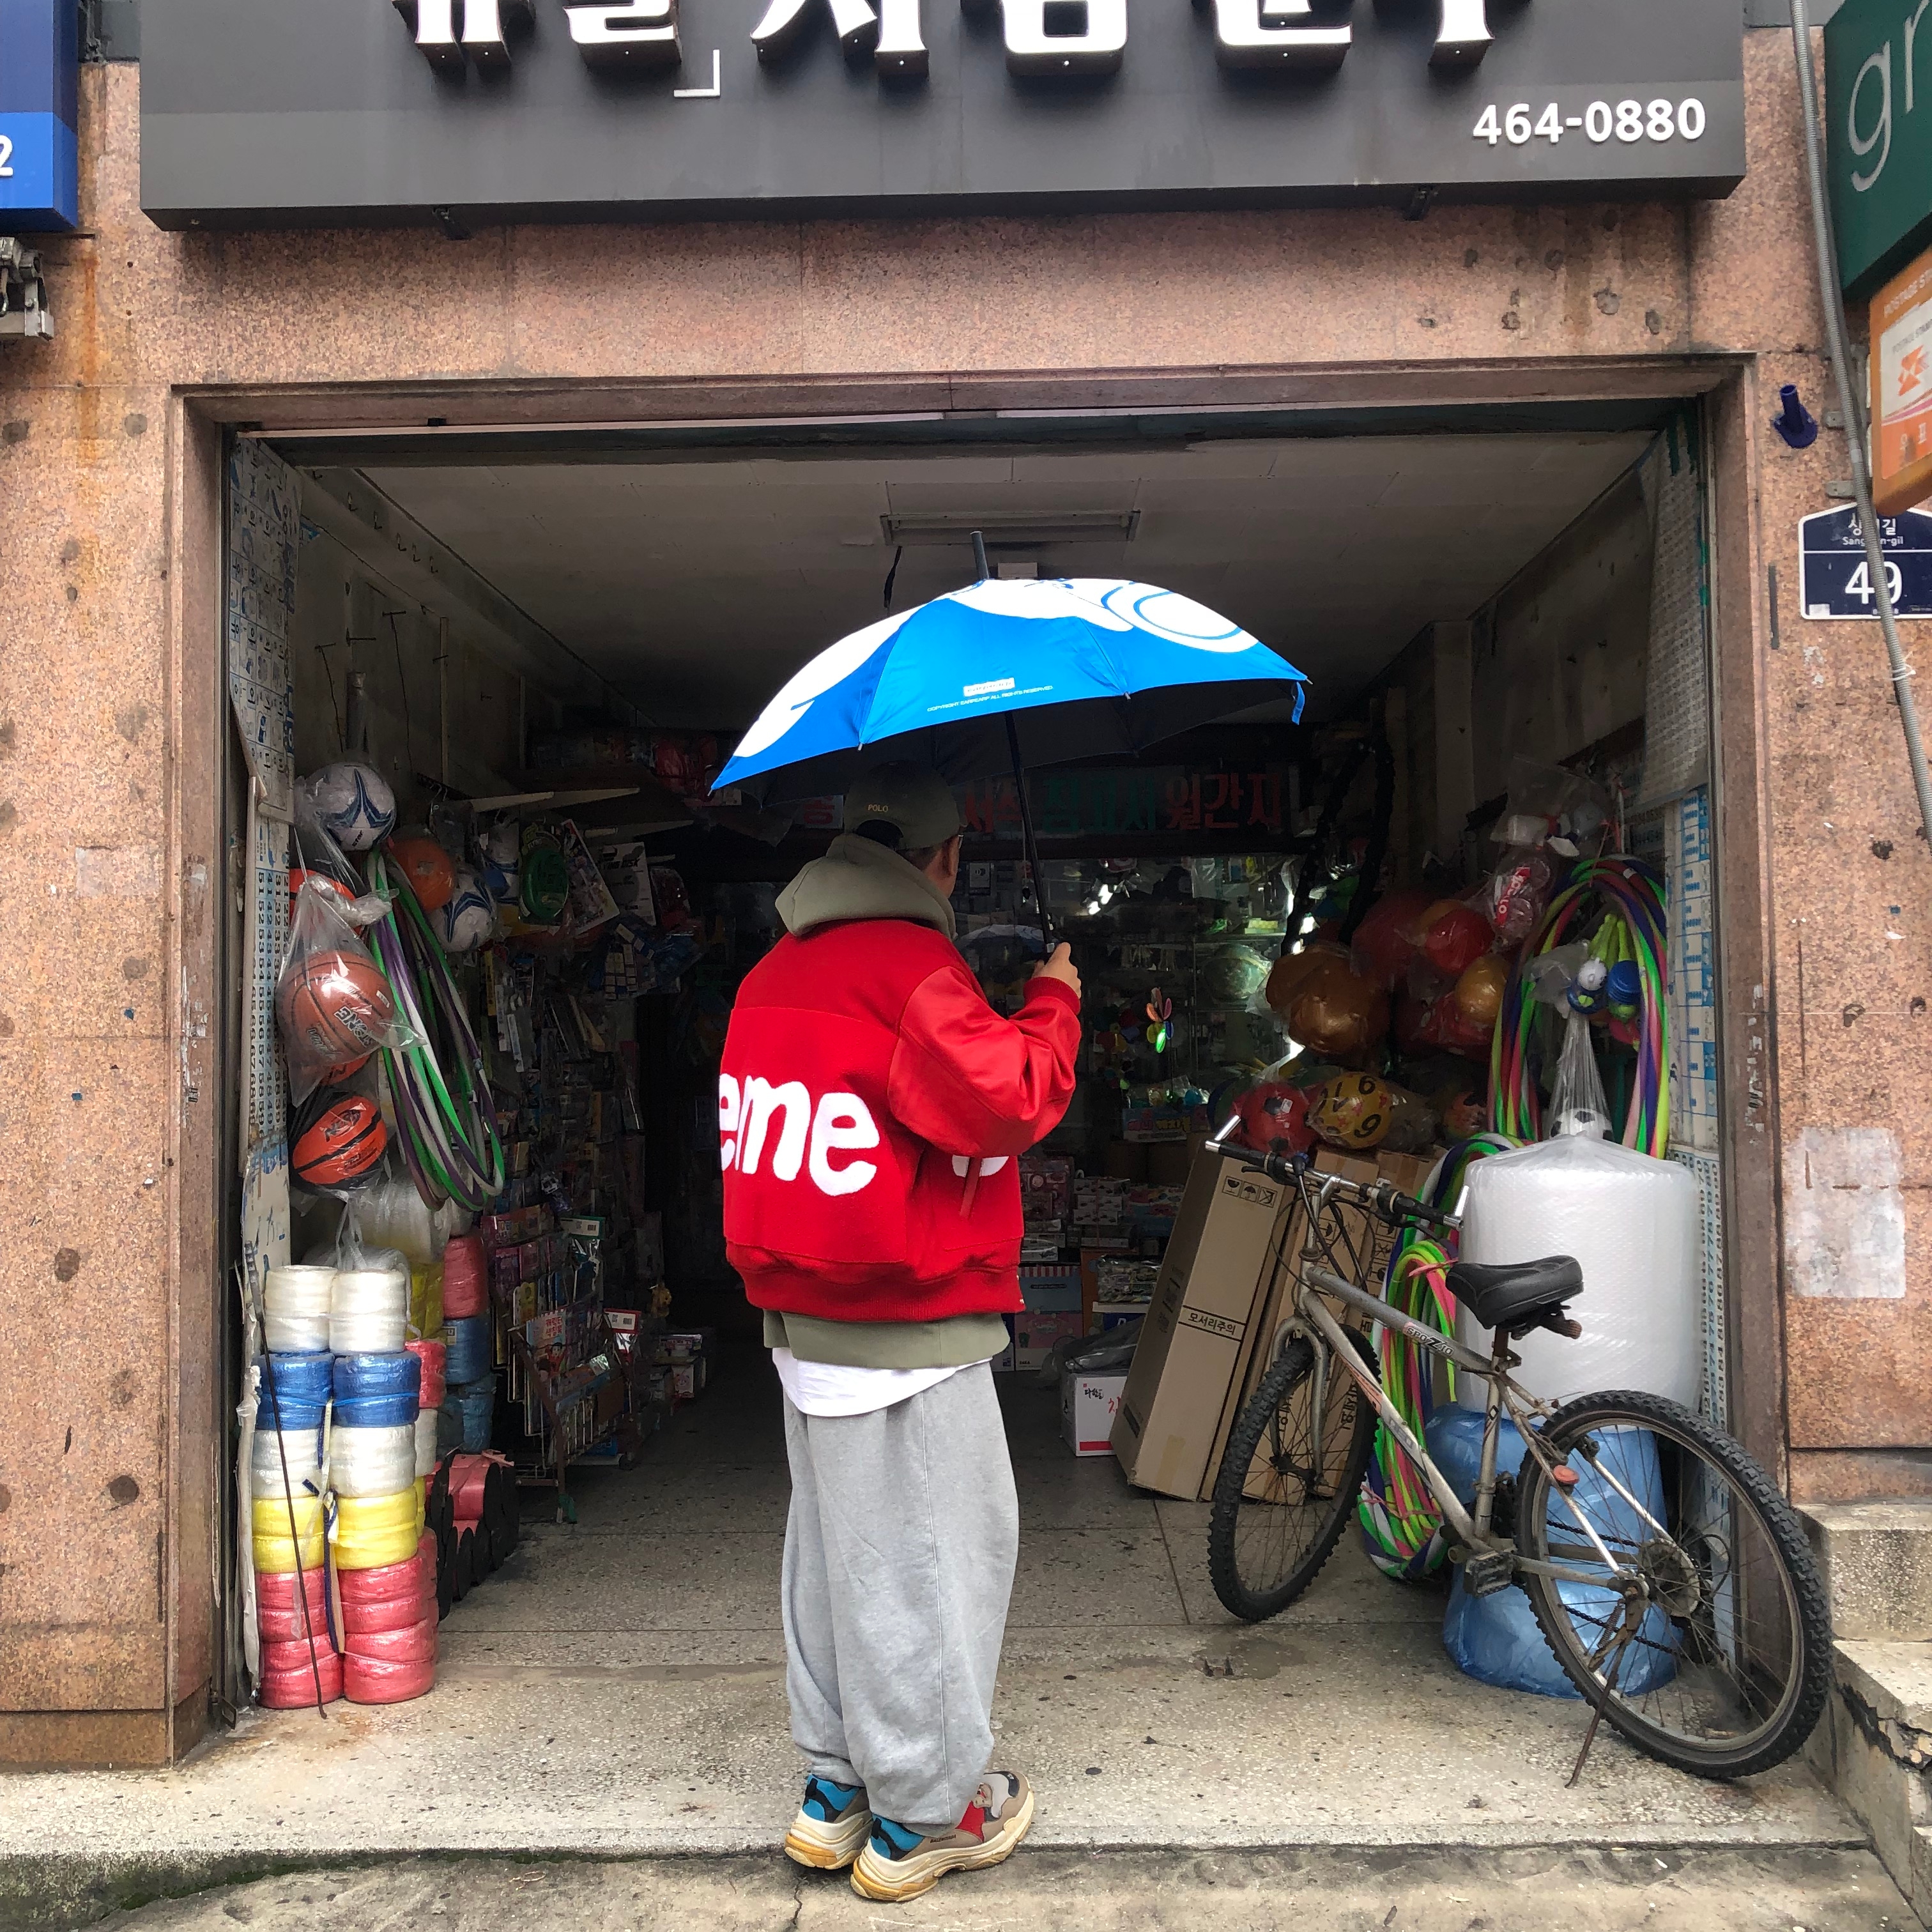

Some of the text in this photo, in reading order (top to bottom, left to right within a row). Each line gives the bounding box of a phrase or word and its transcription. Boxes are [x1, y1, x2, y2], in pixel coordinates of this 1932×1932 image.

[1472, 98, 1706, 146] 464-0880
[1845, 561, 1902, 604] 49
[926, 702, 960, 712] COPYRIGHT
[1001, 690, 1023, 698] RIGHTS
[867, 804, 889, 813] POLO
[1042, 776, 1156, 833] 참고서
[1165, 772, 1281, 830] 월간지
[284, 875, 289, 898] 21
[274, 874, 281, 982] 31 32 33 34
[283, 903, 289, 927] 22
[258, 871, 264, 1125] 51 52 53 54 55 56 57 58 59
[266, 873, 273, 1125] 41 42 43 44 45 46 47 48 49
[250, 1073, 256, 1098] 68
[275, 1071, 280, 1096] 38
[275, 1099, 280, 1123] 39
[719, 1073, 880, 1197] eme
[1188, 1310, 1238, 1336] 모서리주의
